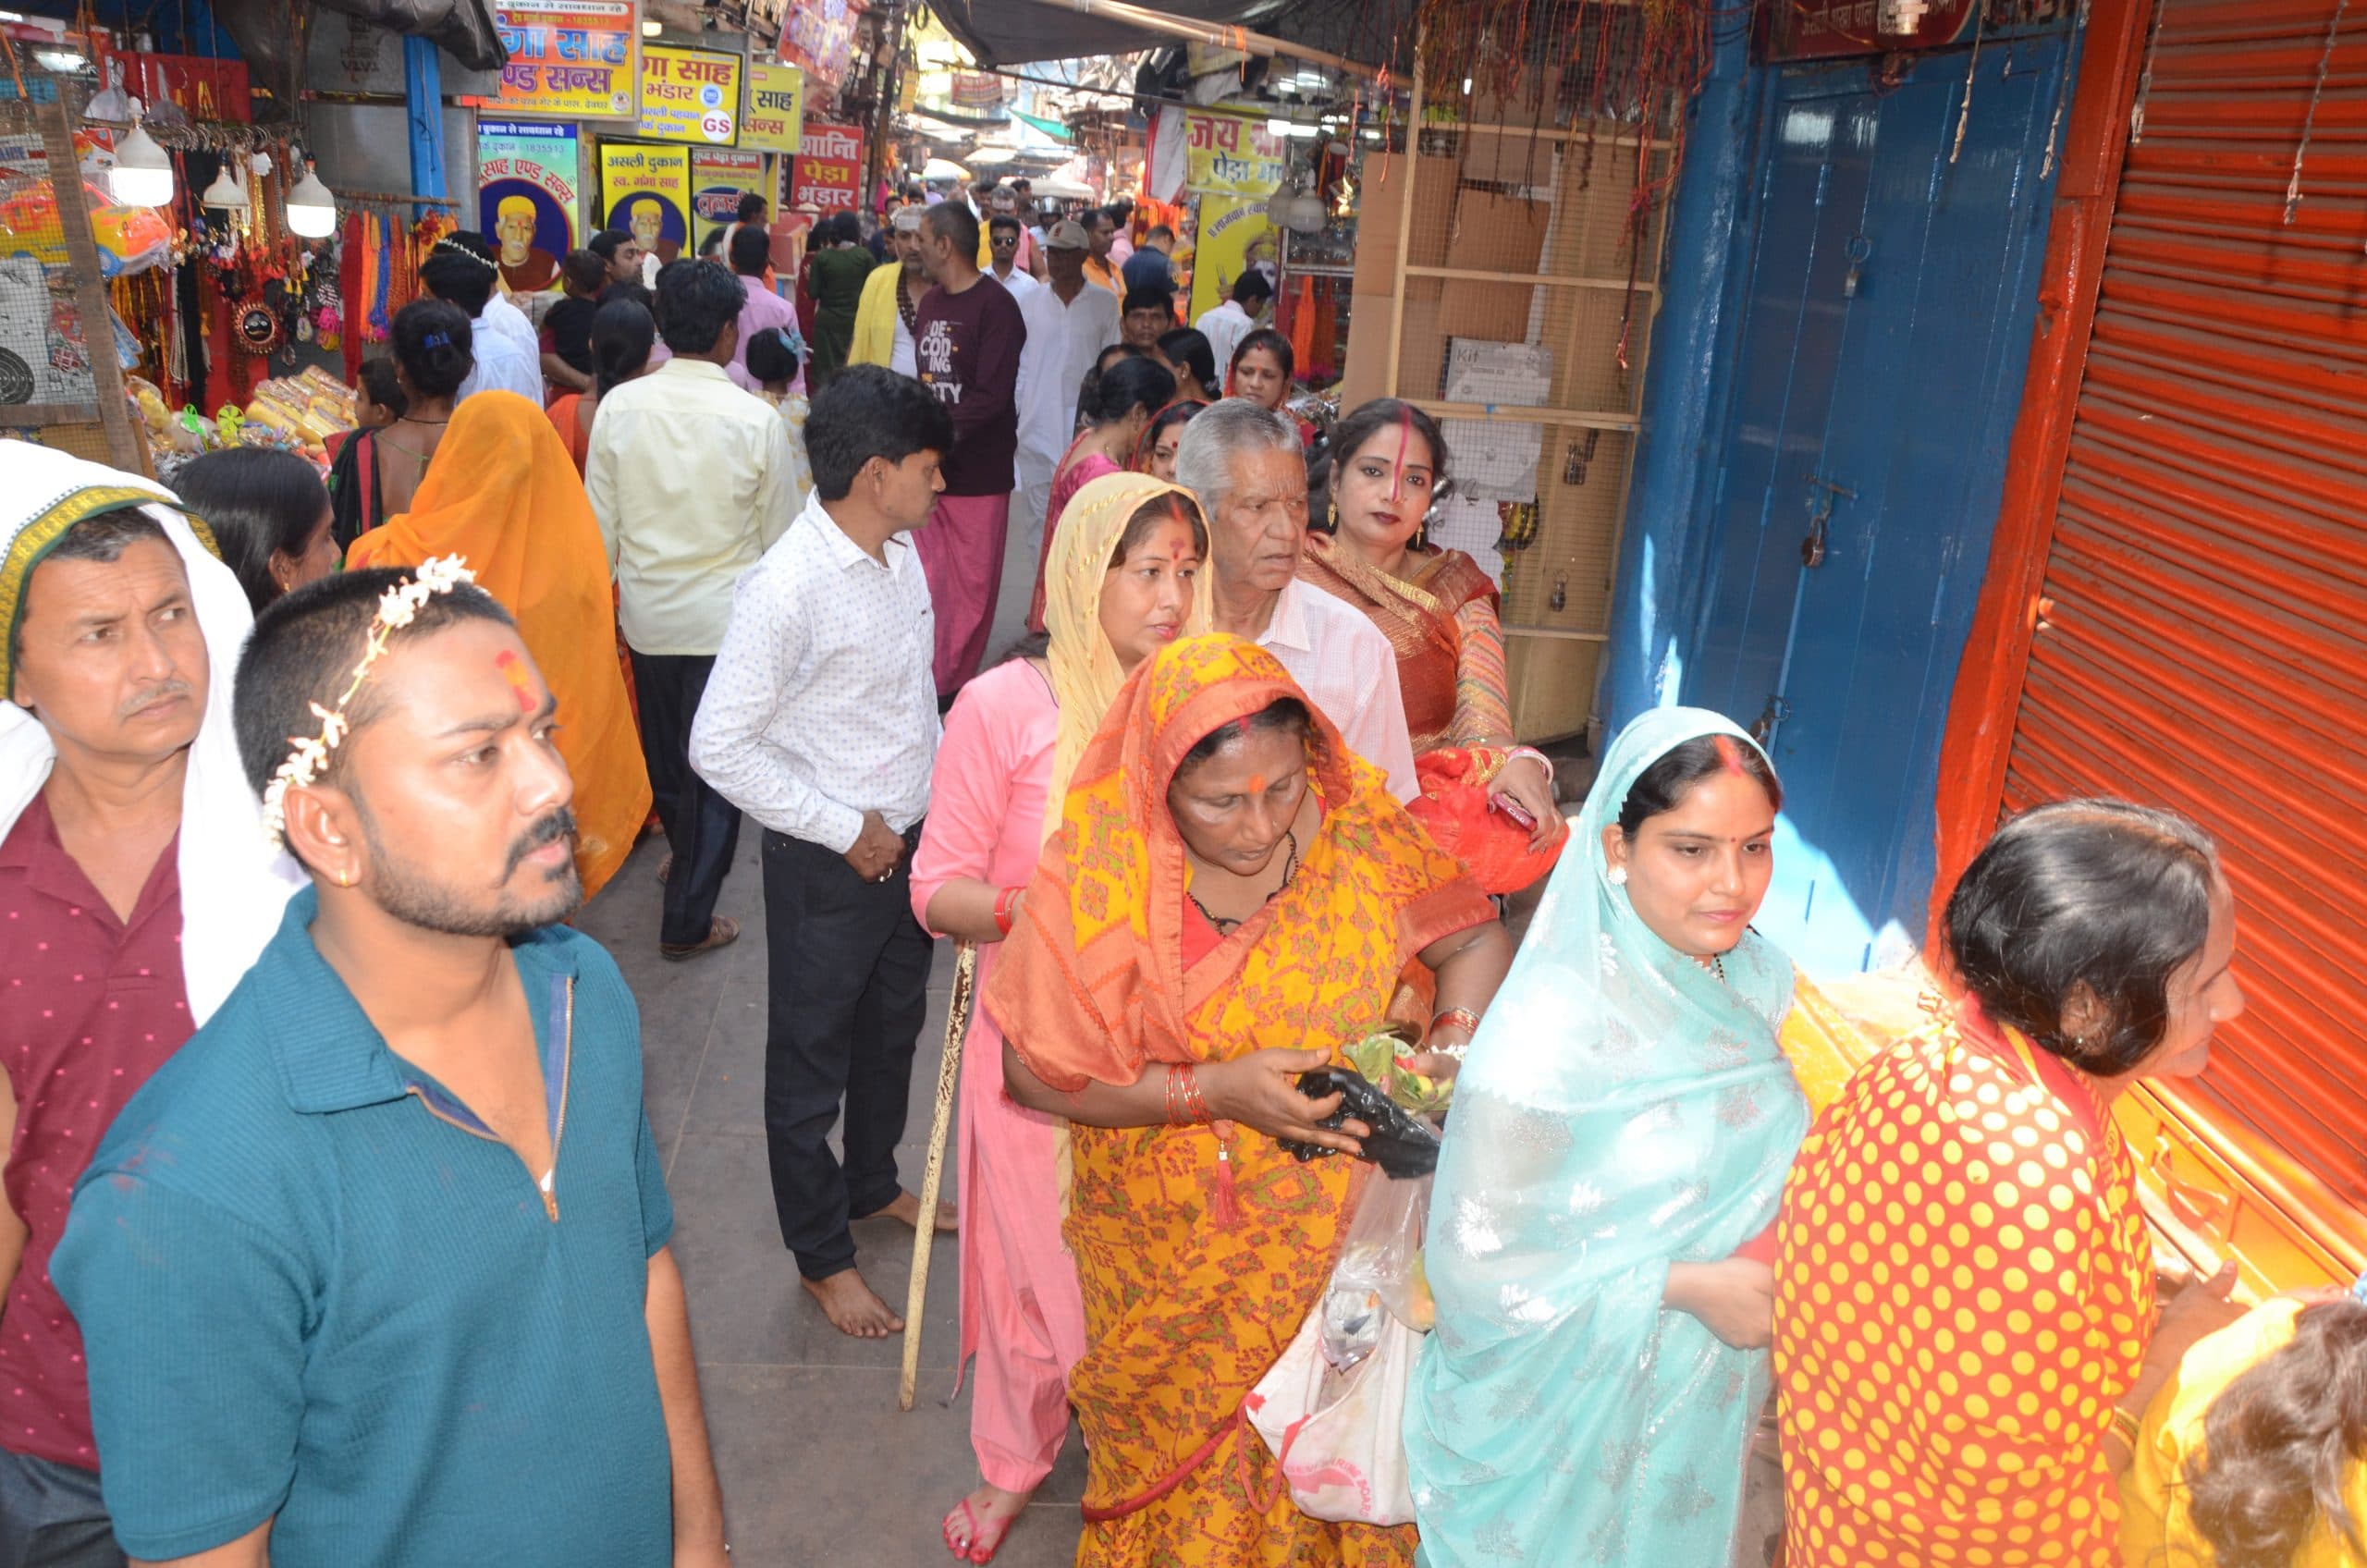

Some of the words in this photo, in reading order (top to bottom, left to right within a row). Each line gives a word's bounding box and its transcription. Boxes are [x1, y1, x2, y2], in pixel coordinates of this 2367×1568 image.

[556, 29, 631, 65] साह
[501, 63, 540, 92] ण्ड
[545, 66, 614, 93] सन्स
[677, 59, 734, 86] साह
[645, 80, 696, 101] भंडार
[756, 91, 793, 112] साह
[703, 117, 730, 133] GS
[742, 117, 785, 135] सन्स
[1188, 115, 1243, 153] जय
[607, 153, 644, 168] असली
[648, 156, 683, 172] दुकान
[803, 160, 850, 184] पेड़ा
[515, 158, 544, 180] एण्ड
[544, 170, 576, 204] सन्स
[658, 177, 680, 190] साह
[798, 179, 854, 207] भंडार
[928, 355, 951, 374] ING
